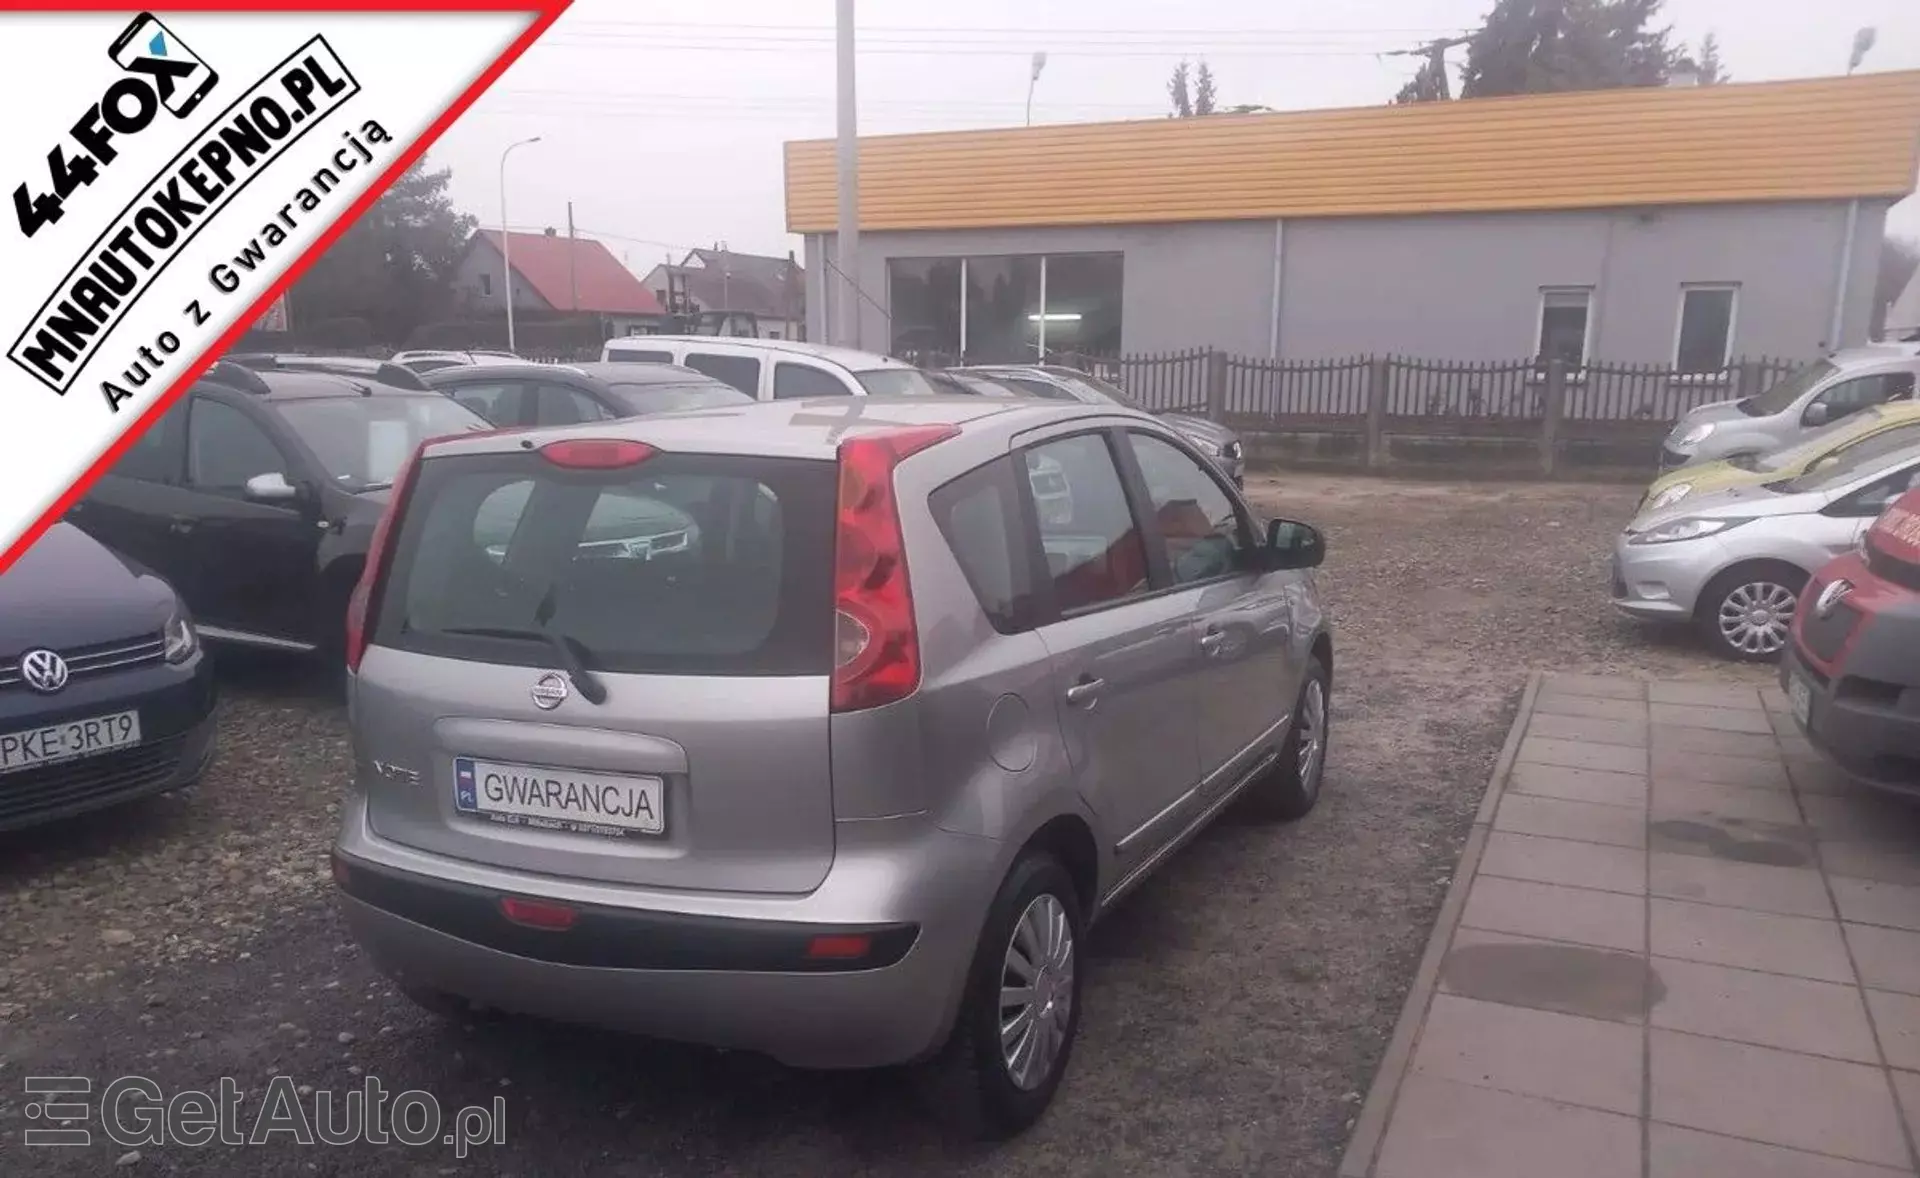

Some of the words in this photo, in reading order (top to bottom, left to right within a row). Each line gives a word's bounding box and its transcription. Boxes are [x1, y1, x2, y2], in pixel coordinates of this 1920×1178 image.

[1, 728, 60, 765] PKE
[67, 714, 132, 750] 3RT9
[484, 773, 654, 819] GWARANCJA
